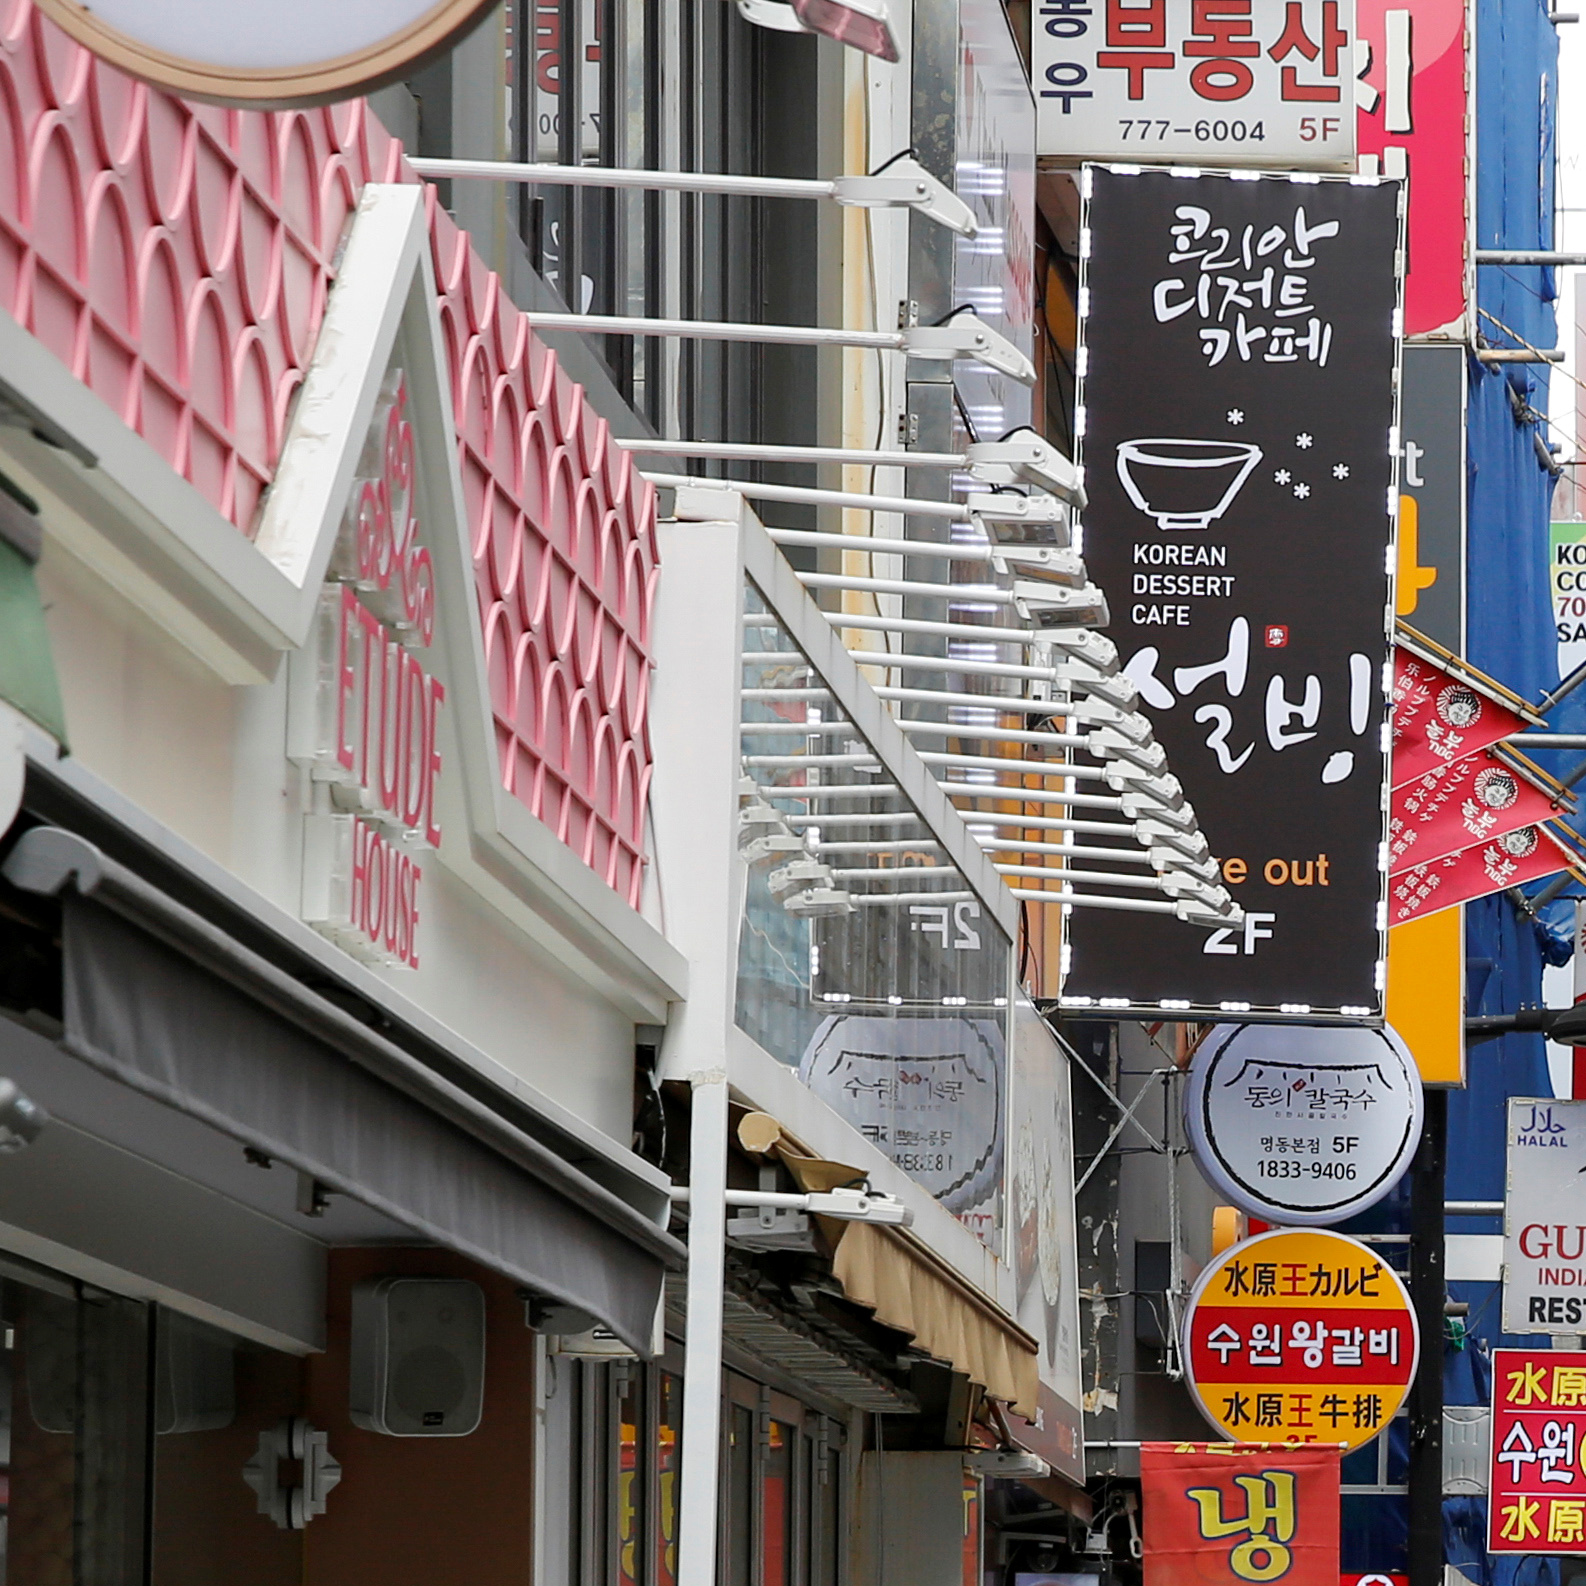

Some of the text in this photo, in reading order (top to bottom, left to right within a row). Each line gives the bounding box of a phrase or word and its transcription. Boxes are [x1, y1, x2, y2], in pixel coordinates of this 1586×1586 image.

[1097, 0, 1348, 103] 부동산
[1117, 116, 1341, 142] 777-6004 5F
[1168, 205, 1340, 273] 코리안
[1153, 267, 1317, 323] 디저트
[1198, 320, 1333, 367] 카페
[1132, 543, 1227, 567] KOREAN
[1132, 574, 1236, 598] DESSERT
[1130, 603, 1192, 626] CAFE
[1120, 615, 1373, 784] 설빙
[335, 589, 446, 851] ETUDE
[1263, 852, 1329, 887] out
[351, 811, 423, 970] HOUSE
[1202, 912, 1276, 955] 2F
[1259, 1136, 1360, 1154] 명동본점 5F
[1516, 1134, 1569, 1149] HALAL
[1256, 1159, 1357, 1181] 1833-9406
[1223, 1260, 1383, 1298] 水原王カルビ
[1206, 1319, 1398, 1370] 수원왕갈비
[1222, 1390, 1383, 1430] 水原王牛排
